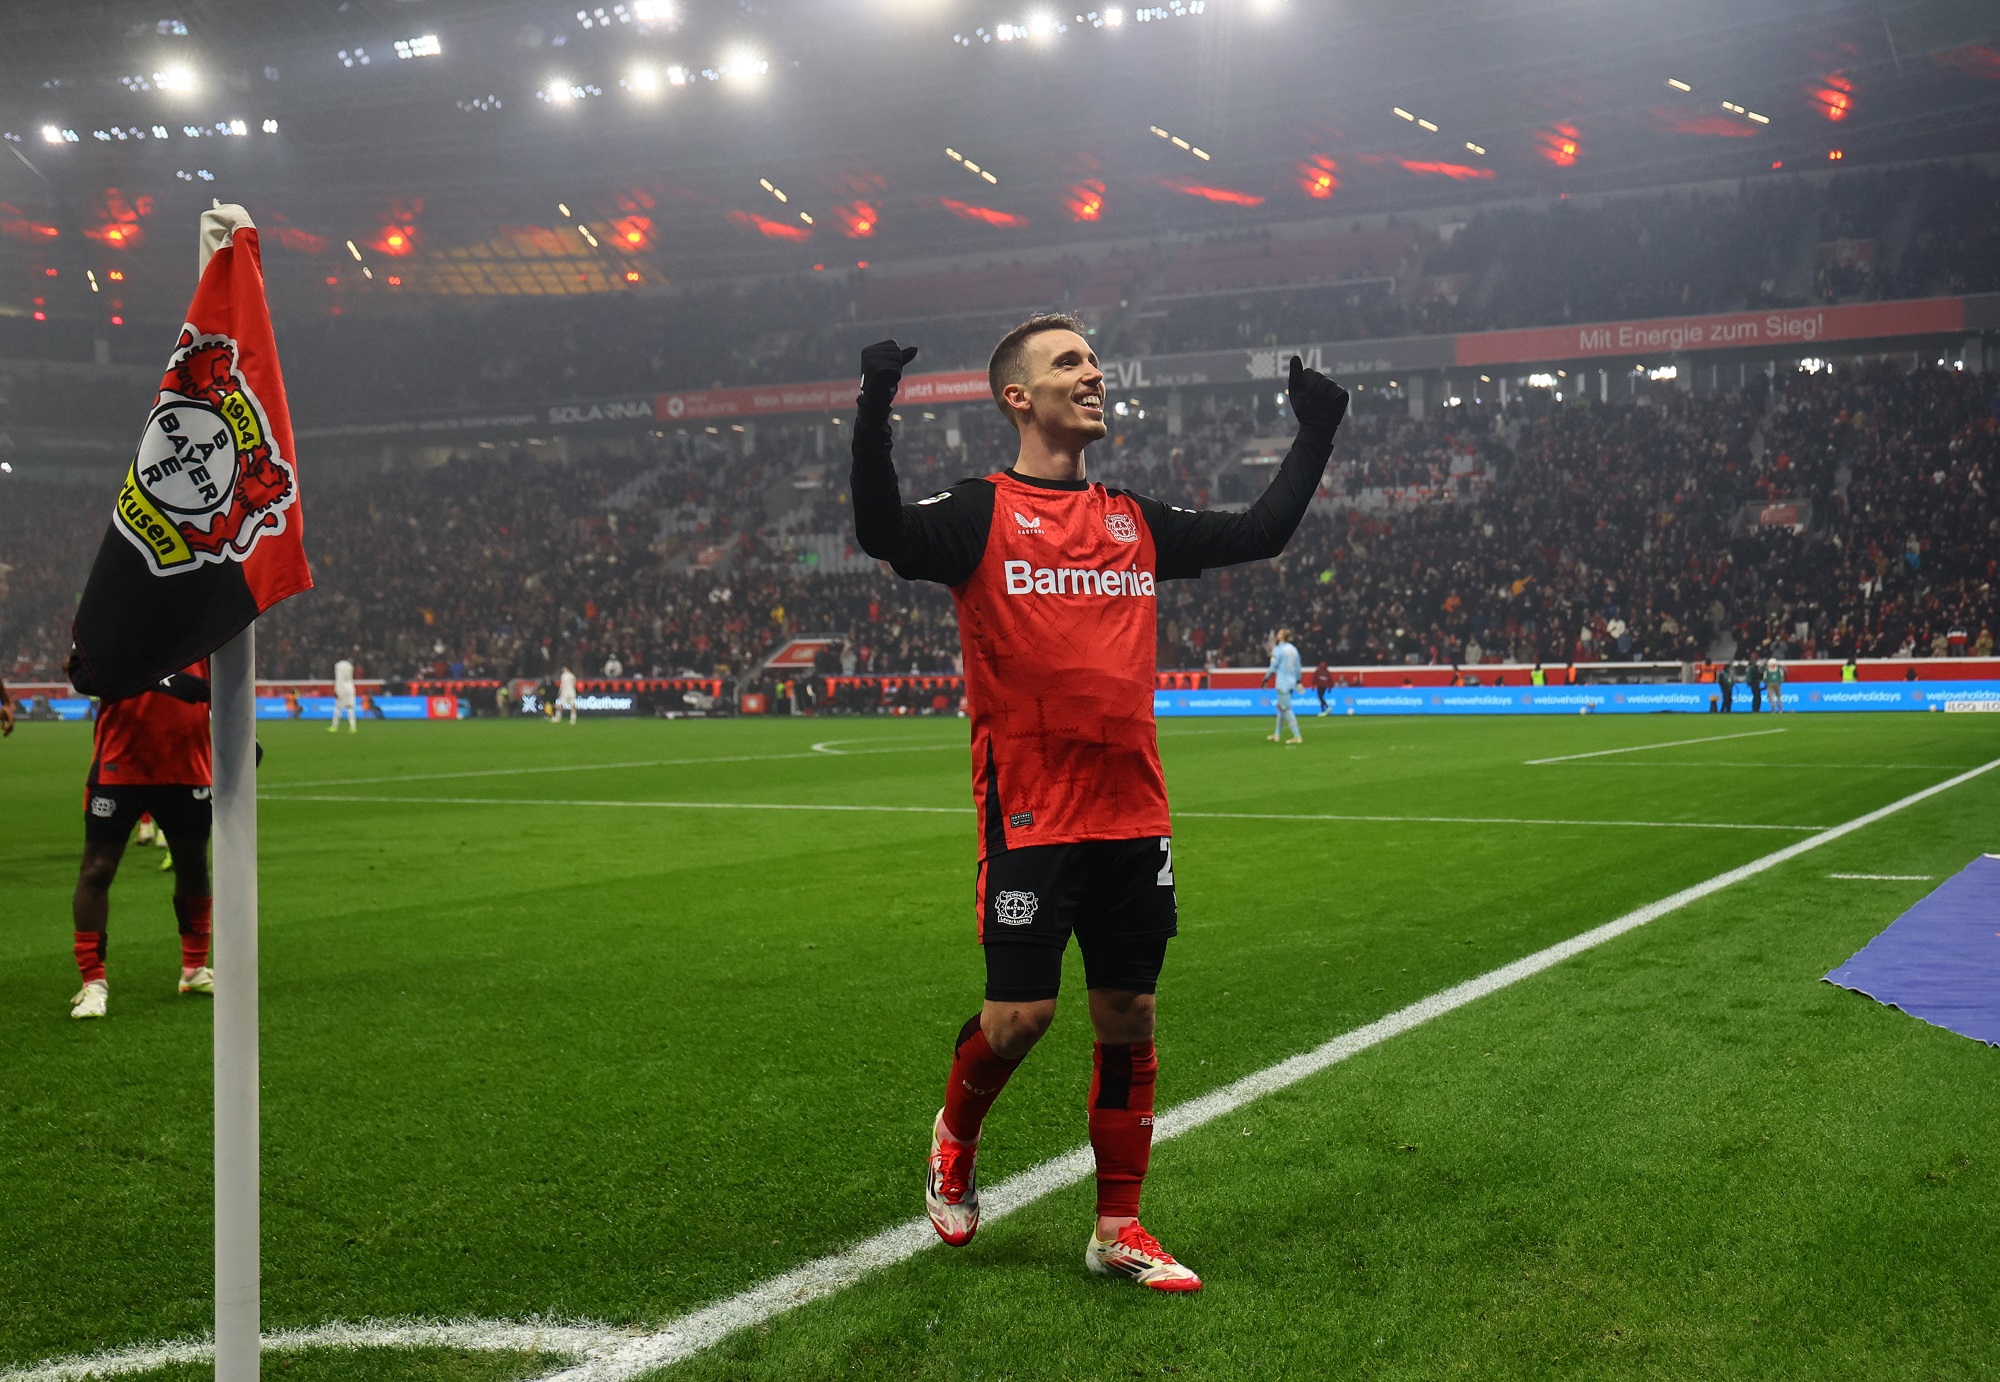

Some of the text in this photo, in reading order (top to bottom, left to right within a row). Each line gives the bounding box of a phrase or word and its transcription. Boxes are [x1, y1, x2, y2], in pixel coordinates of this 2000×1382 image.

[1579, 313, 1824, 350] Mit Energie zum Sieg!
[1100, 361, 1151, 389] EVL
[225, 396, 255, 445] 1904
[141, 428, 229, 488] BAYER
[157, 412, 219, 504] BAYER
[1003, 560, 1156, 597] Barmenia
[1355, 695, 1423, 707] weloveholidays
[1443, 694, 1512, 706] weloveholidays
[1533, 694, 1605, 705] weloveholidays
[1626, 693, 1700, 705] weloveholidays
[1822, 691, 1902, 704] weloveholidays
